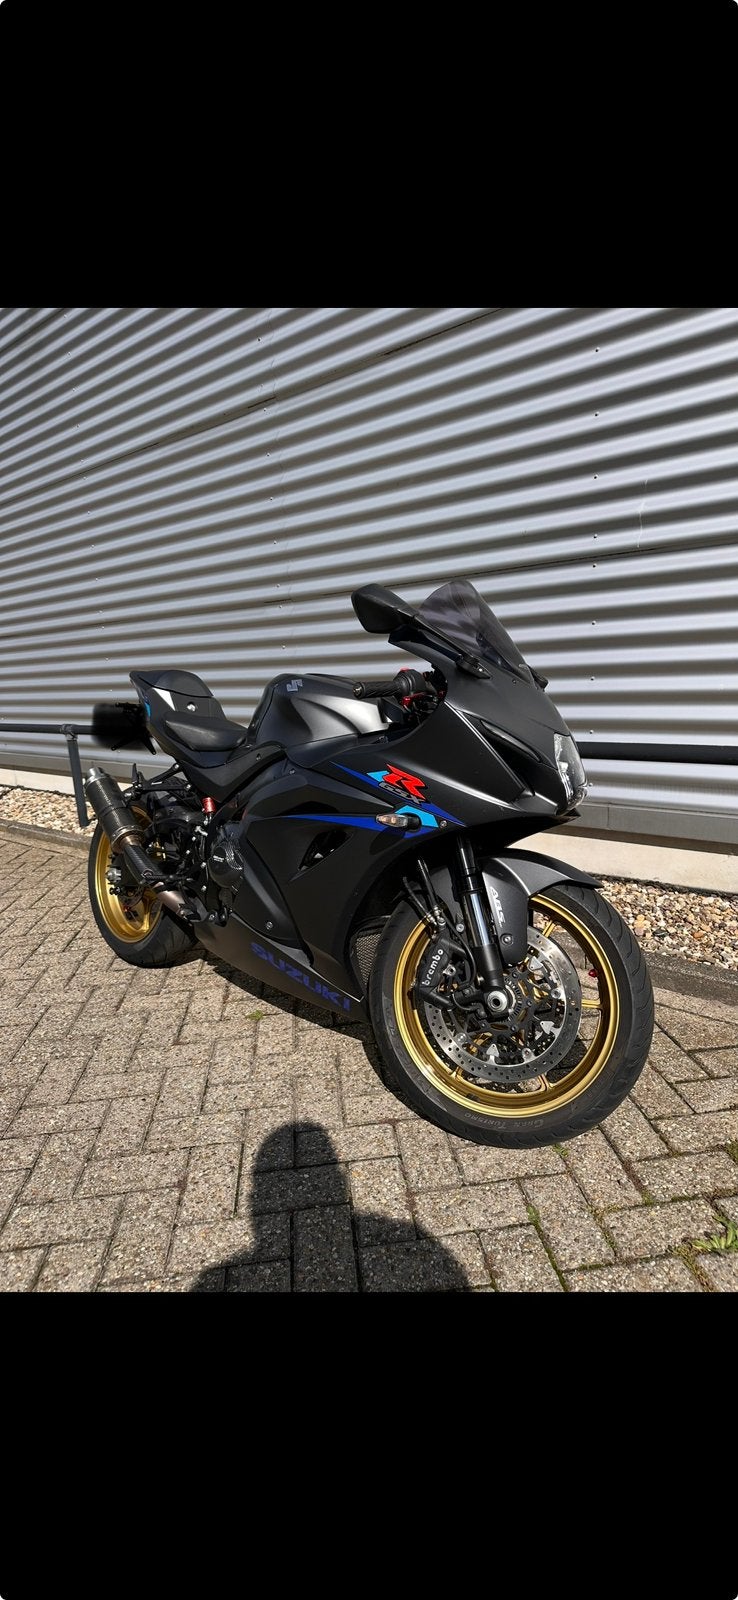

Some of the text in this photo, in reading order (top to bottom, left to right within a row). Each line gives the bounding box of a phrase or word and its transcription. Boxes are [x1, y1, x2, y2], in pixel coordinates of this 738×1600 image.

[379, 781, 426, 804] GSX
[383, 763, 426, 802] R
[490, 886, 505, 928] ABS
[250, 942, 351, 1011] SUZUKI
[422, 949, 444, 986] brembo
